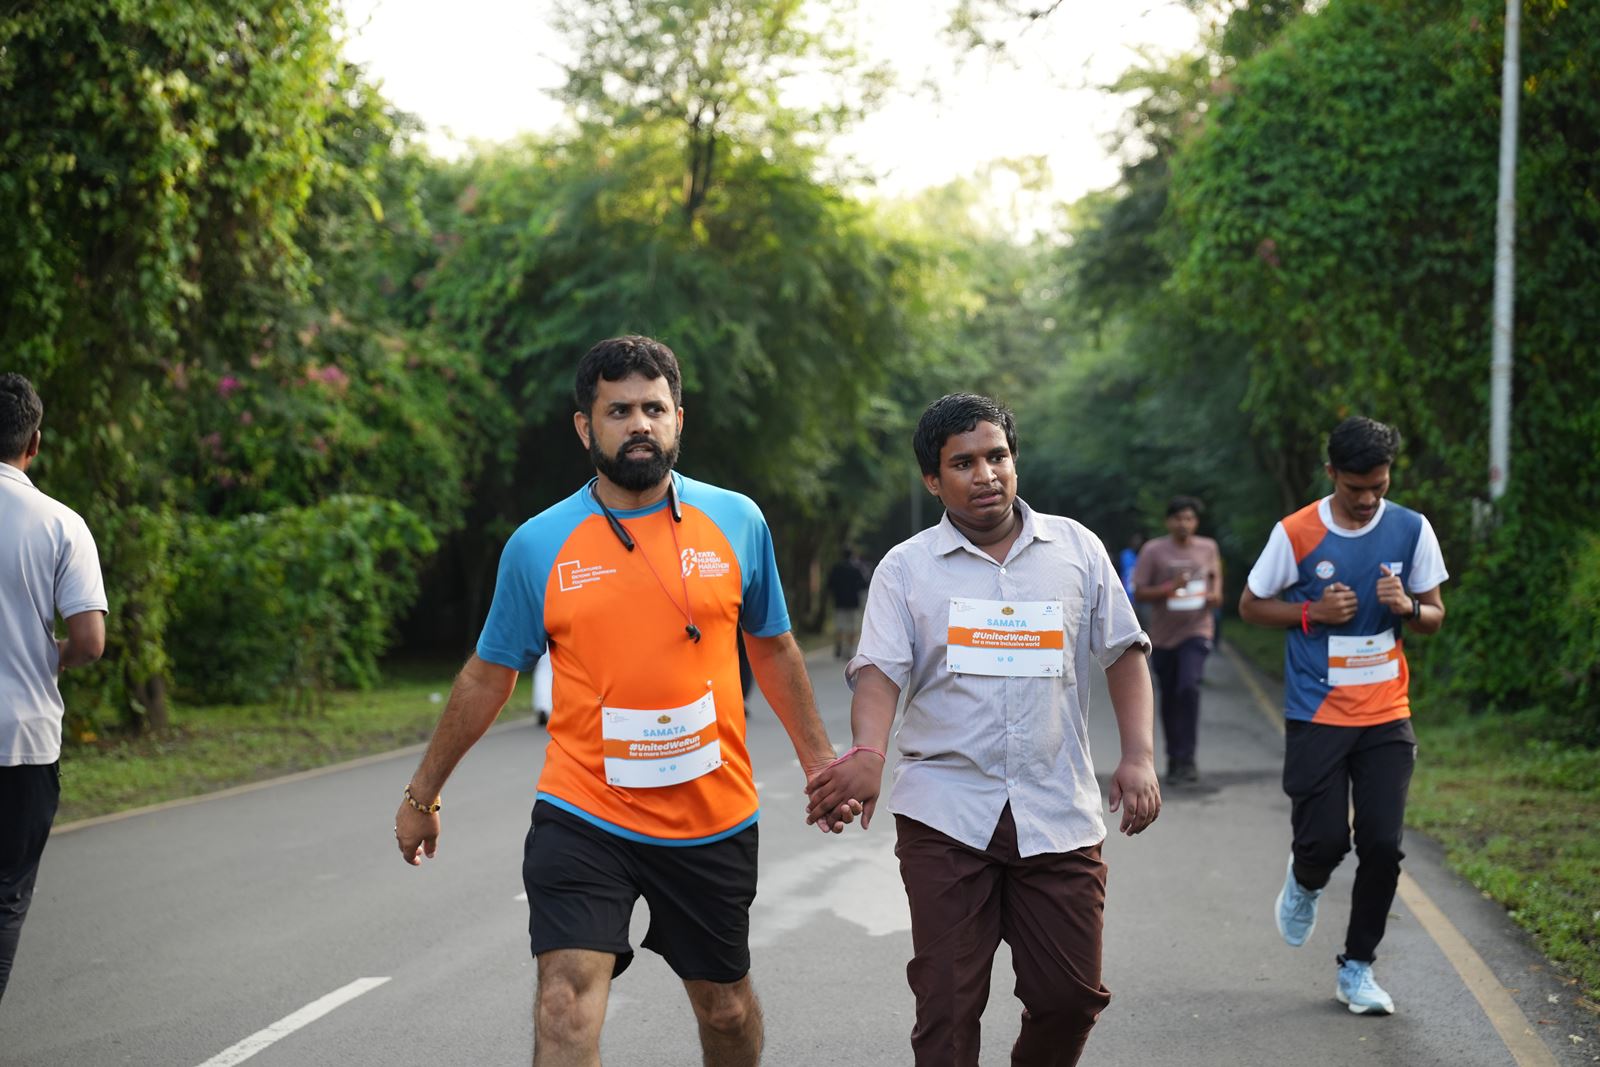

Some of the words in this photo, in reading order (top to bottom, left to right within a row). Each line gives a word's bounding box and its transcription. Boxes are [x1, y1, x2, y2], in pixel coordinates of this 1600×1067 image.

[987, 618, 1027, 628] SAMATA
[972, 632, 1040, 642] #UnitedWeRun
[643, 726, 686, 737] SAMATA
[629, 736, 701, 751] #UnitedWeRun
